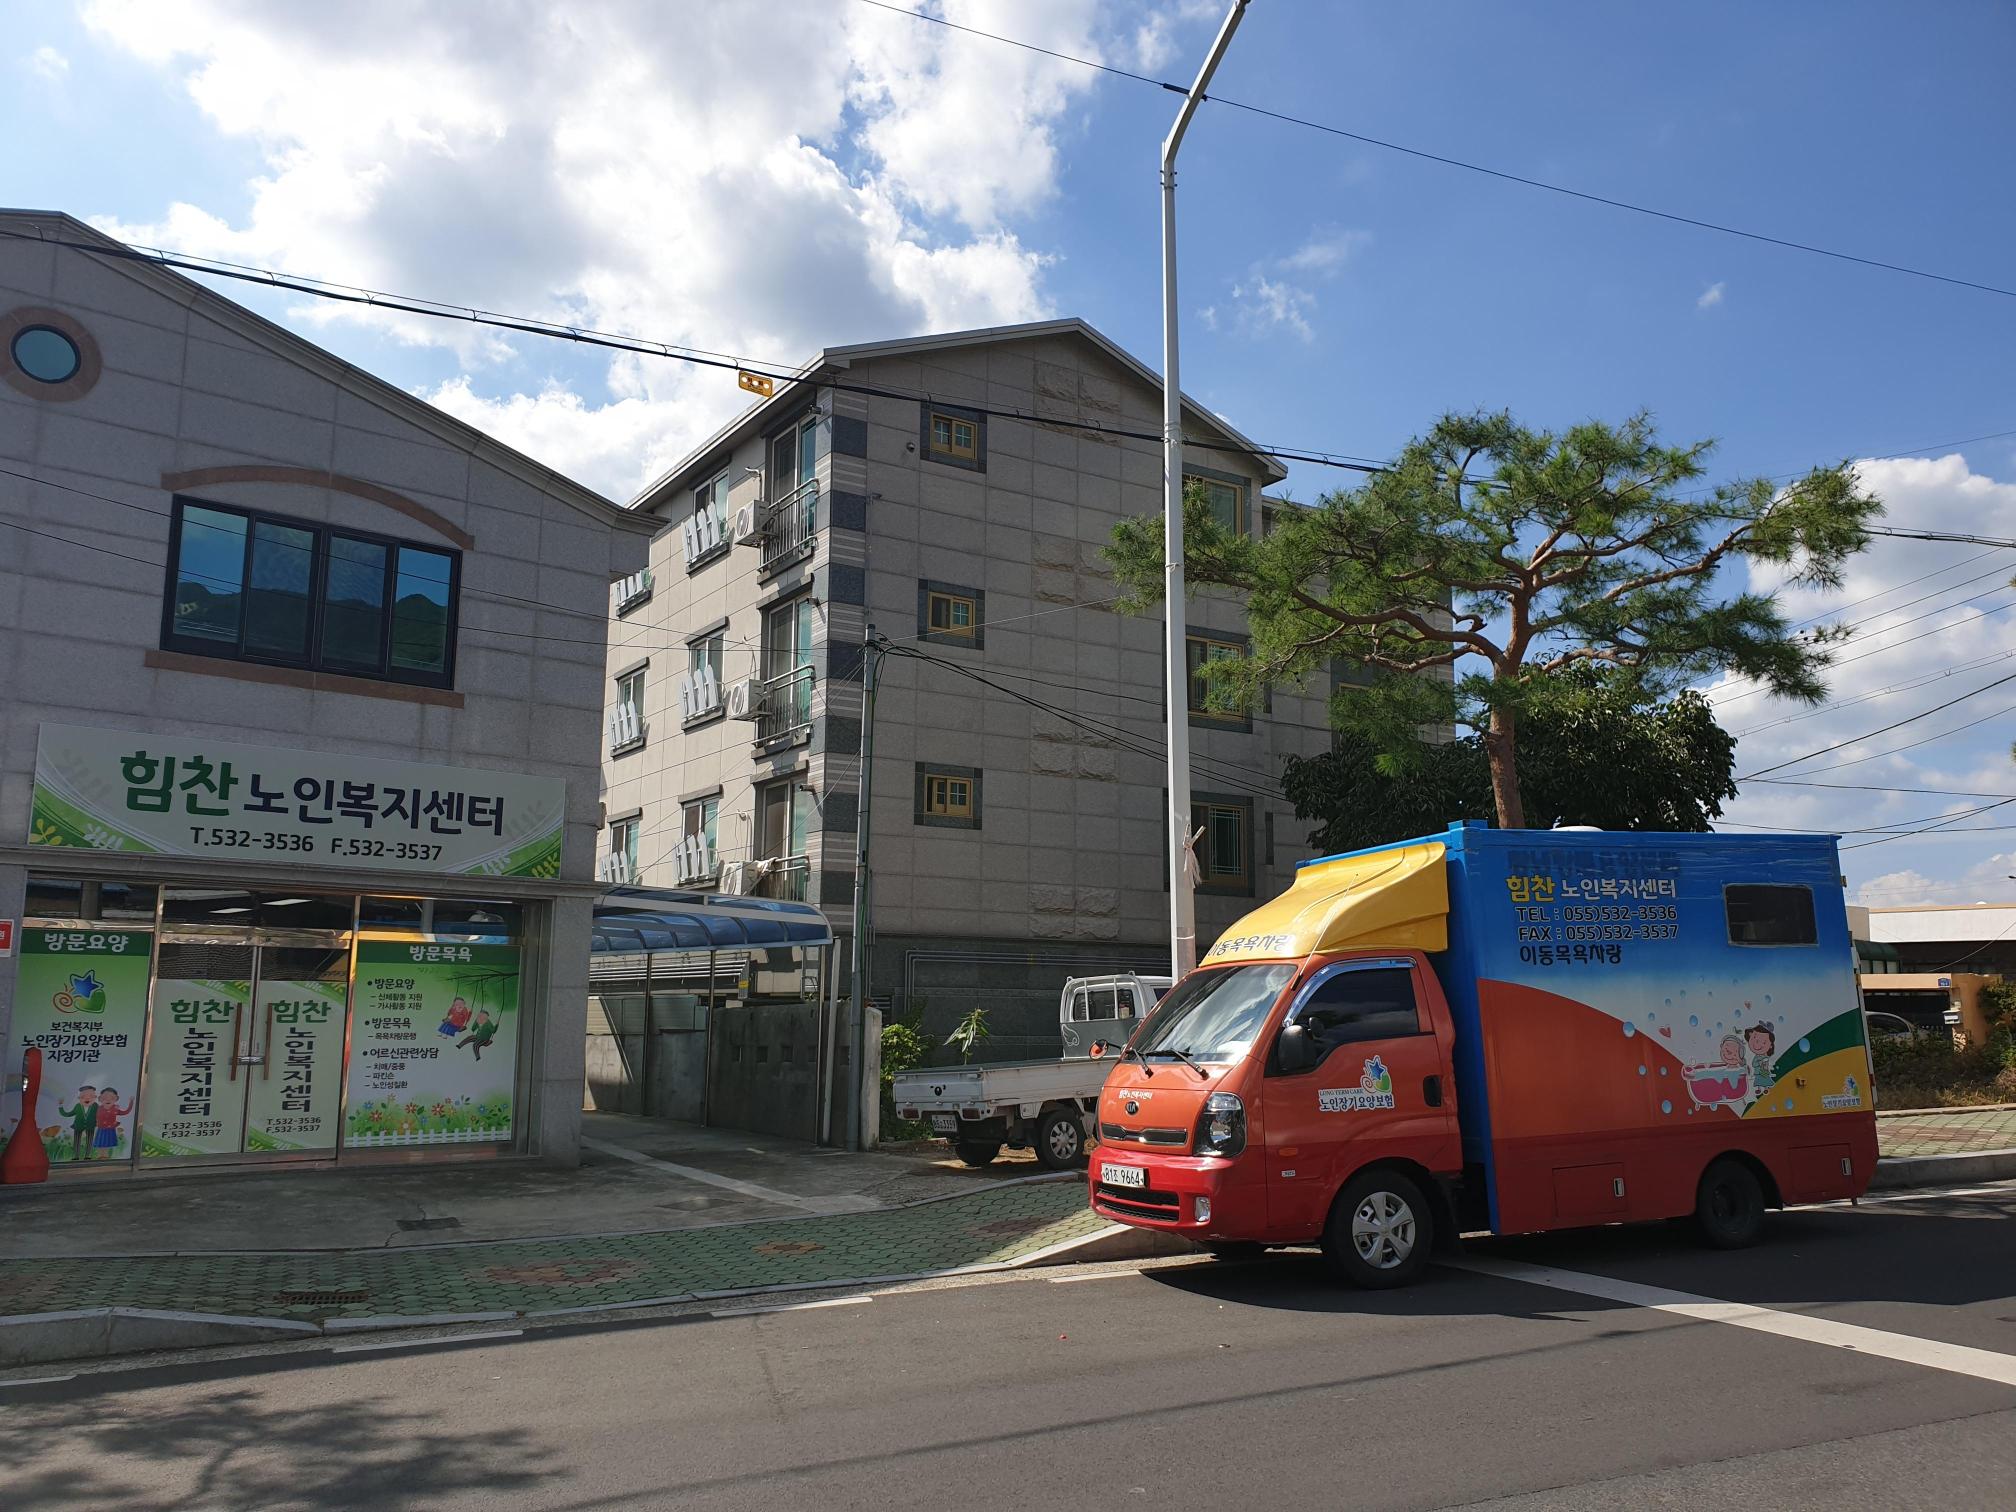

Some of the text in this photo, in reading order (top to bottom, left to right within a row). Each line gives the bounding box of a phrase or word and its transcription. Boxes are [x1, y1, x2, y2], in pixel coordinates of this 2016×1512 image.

[120, 750, 504, 836] 힘찬 노인복지센터
[190, 826, 442, 861] T.532-3536 F.532-3537
[1505, 874, 1677, 902] 힘찬 노인복지센터
[1515, 906, 1550, 922] TEL
[1563, 905, 1678, 922] 055)532-3536
[1518, 925, 1553, 941] FAX
[1565, 924, 1679, 941] 055)532-3537
[44, 933, 129, 953] 방문요양
[409, 945, 473, 962] 방문목욕
[1519, 943, 1622, 966] 이동목욕차량
[374, 978, 415, 990] 방문요양
[170, 999, 235, 1024] 힘찬
[272, 999, 332, 1024] 힘찬
[50, 1021, 104, 1032] 보건복지부
[371, 1017, 412, 1029] 방문목욕
[21, 1034, 128, 1048] 노인장기요양보험
[47, 1049, 102, 1062] 지정기관
[370, 1047, 439, 1059] 어르신관련상담
[177, 1027, 218, 1116] 노인복지센터
[280, 1026, 317, 1112] 노인복지센터
[1320, 1094, 1393, 1110] 노인장기요양보험
[163, 1121, 222, 1130] T.532-3536
[266, 1124, 321, 1134] F.532-3537
[267, 1117, 322, 1126] T.532-3536
[161, 1129, 221, 1139] F.532-3537
[1120, 1169, 1140, 1186] 9664
